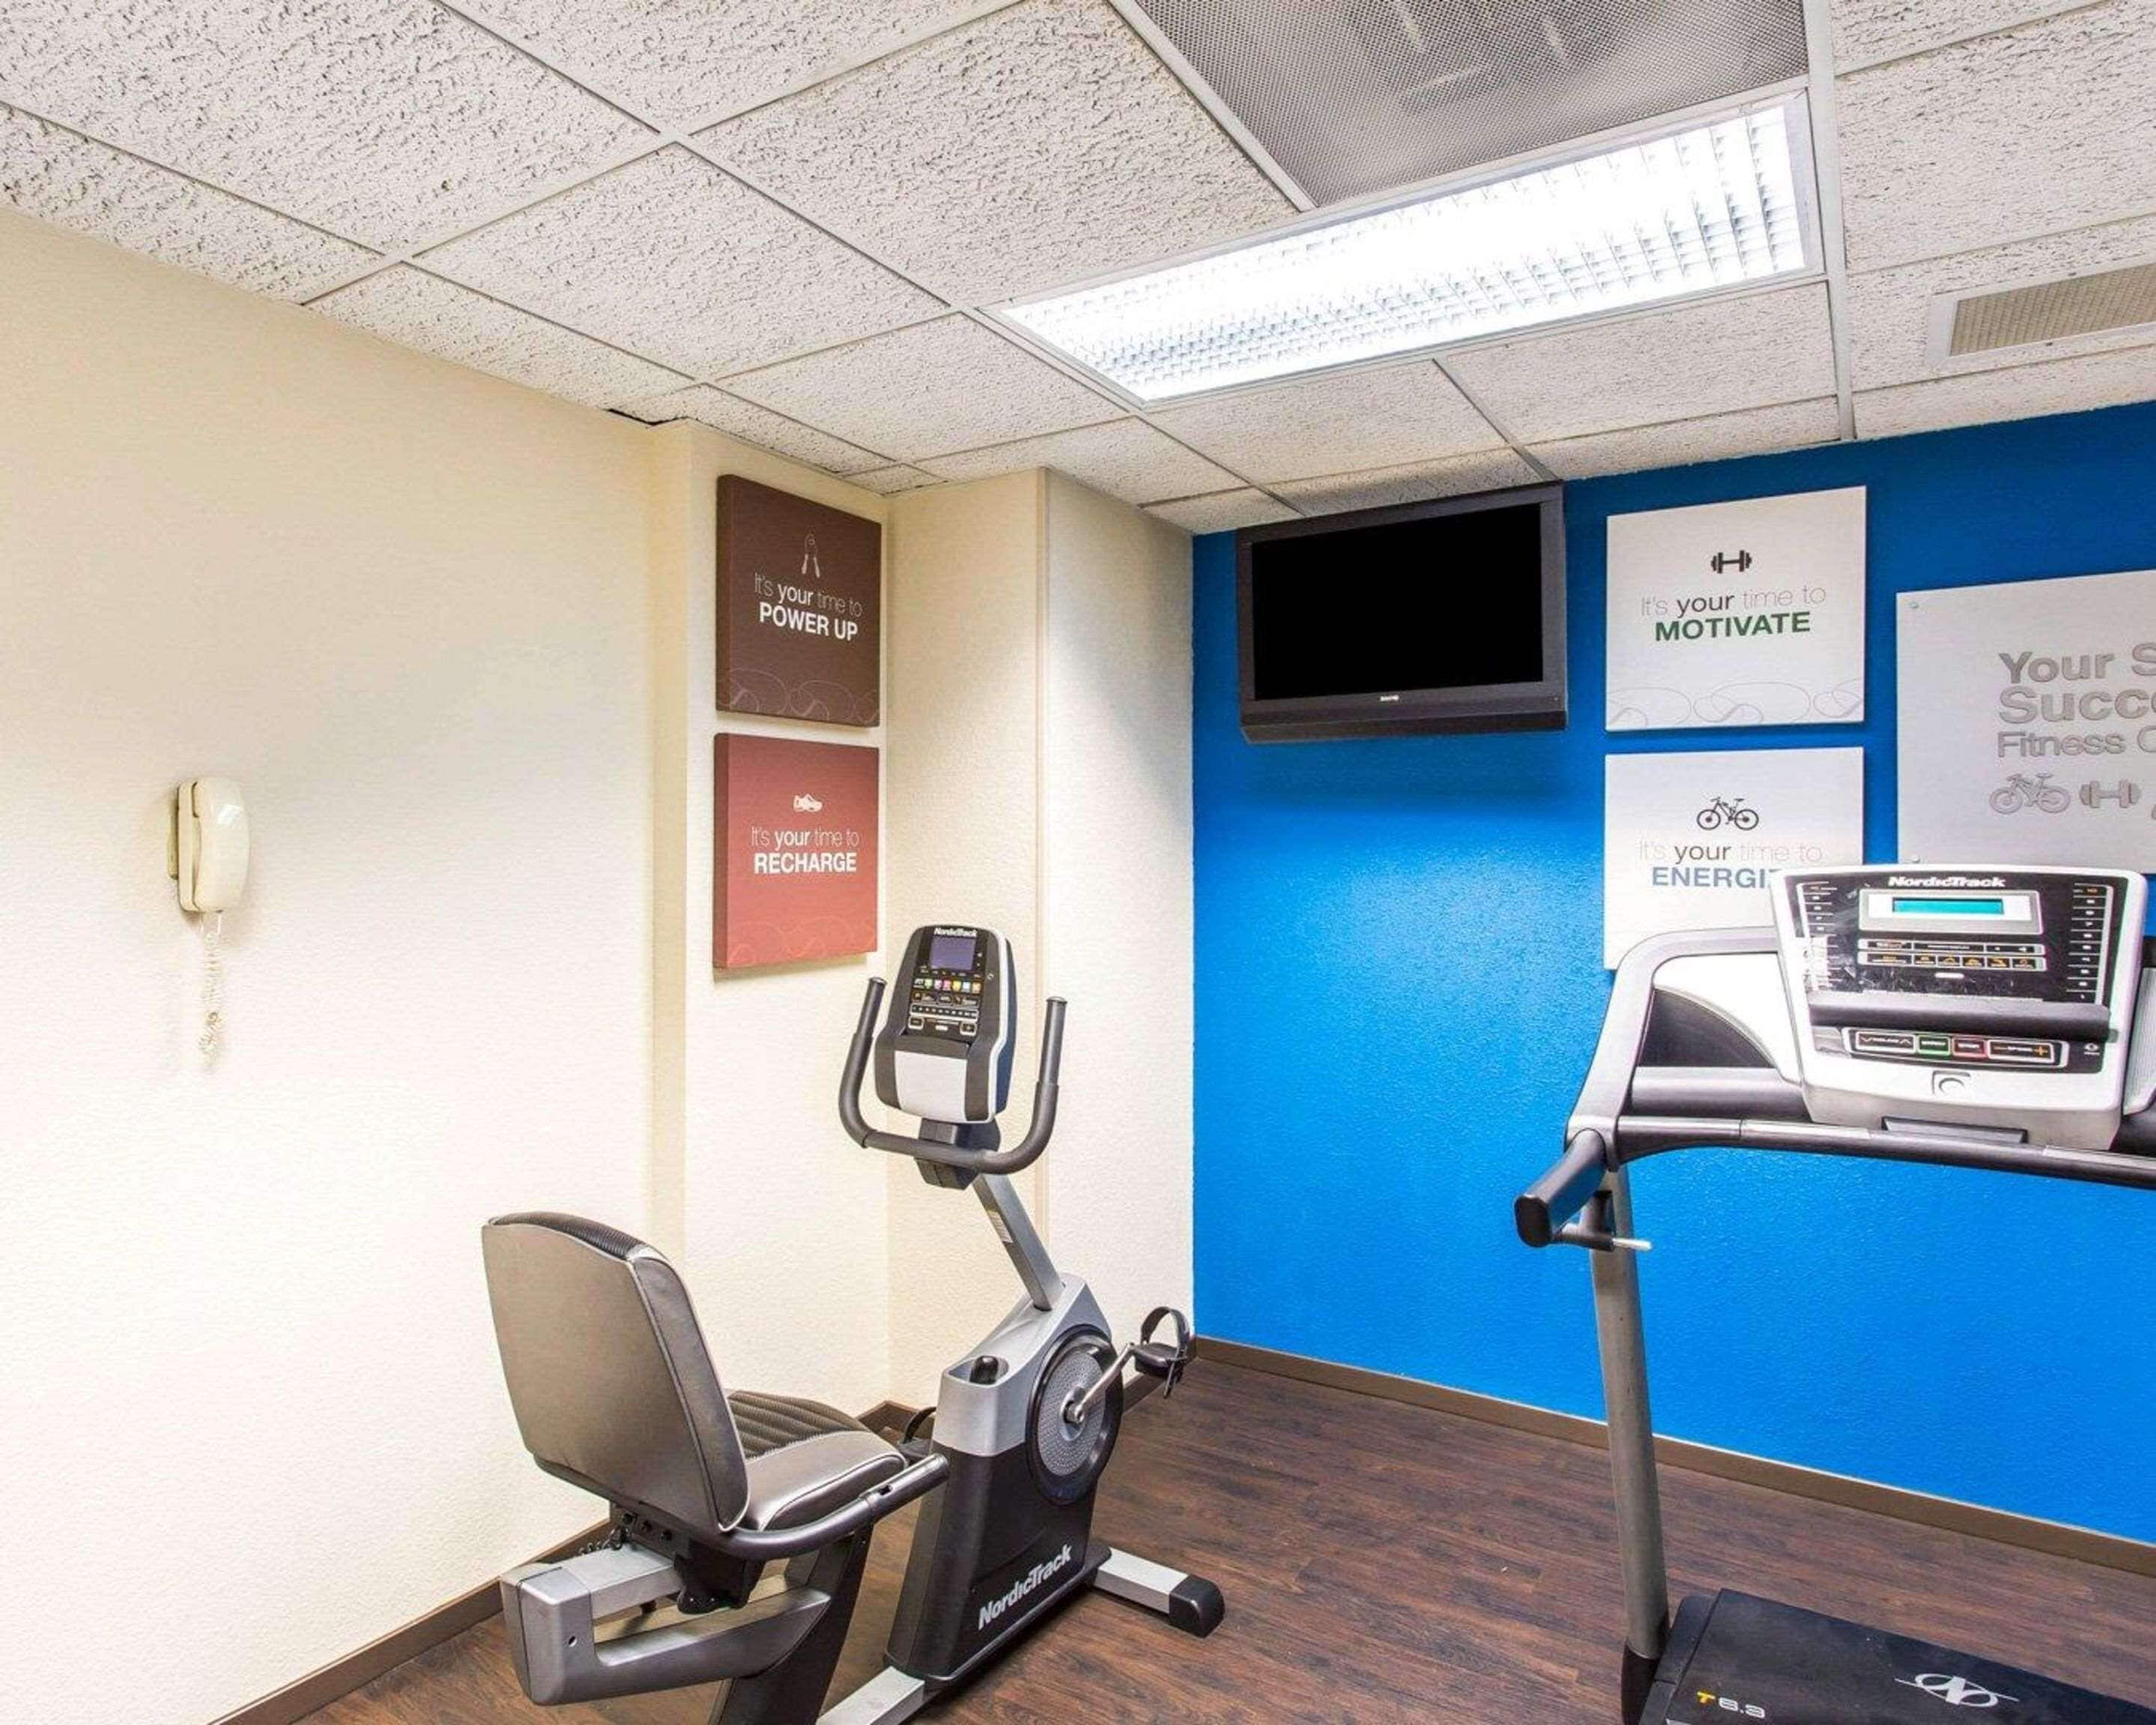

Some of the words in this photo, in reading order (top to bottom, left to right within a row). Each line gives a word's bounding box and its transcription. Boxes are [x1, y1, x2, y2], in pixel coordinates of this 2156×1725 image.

[754, 572, 773, 597] It's
[777, 583, 814, 606] your
[817, 589, 845, 613] time
[849, 599, 862, 617] to
[1641, 596, 1668, 616] It's
[1677, 594, 1735, 618] your
[1743, 589, 1793, 609] time
[1803, 585, 1827, 604] to
[758, 602, 829, 636] POWER
[834, 618, 859, 642] UP
[1655, 611, 1811, 642] MOTIVATE
[1998, 651, 2115, 684] Your
[1998, 684, 2156, 725] Succ
[1997, 731, 2126, 758] Fitness
[751, 826, 770, 847] It's
[774, 830, 811, 851] your
[814, 827, 843, 848] time
[846, 828, 859, 847] to
[1639, 840, 1666, 860] It's
[1674, 845, 1732, 865] your
[1741, 842, 1790, 861] time
[1799, 844, 1823, 862] to
[754, 852, 857, 874] RECHARGE
[1652, 866, 1782, 889] ENERGI
[1888, 875, 2006, 888] NordicTrack
[978, 1543, 1072, 1631] NordicTrack
